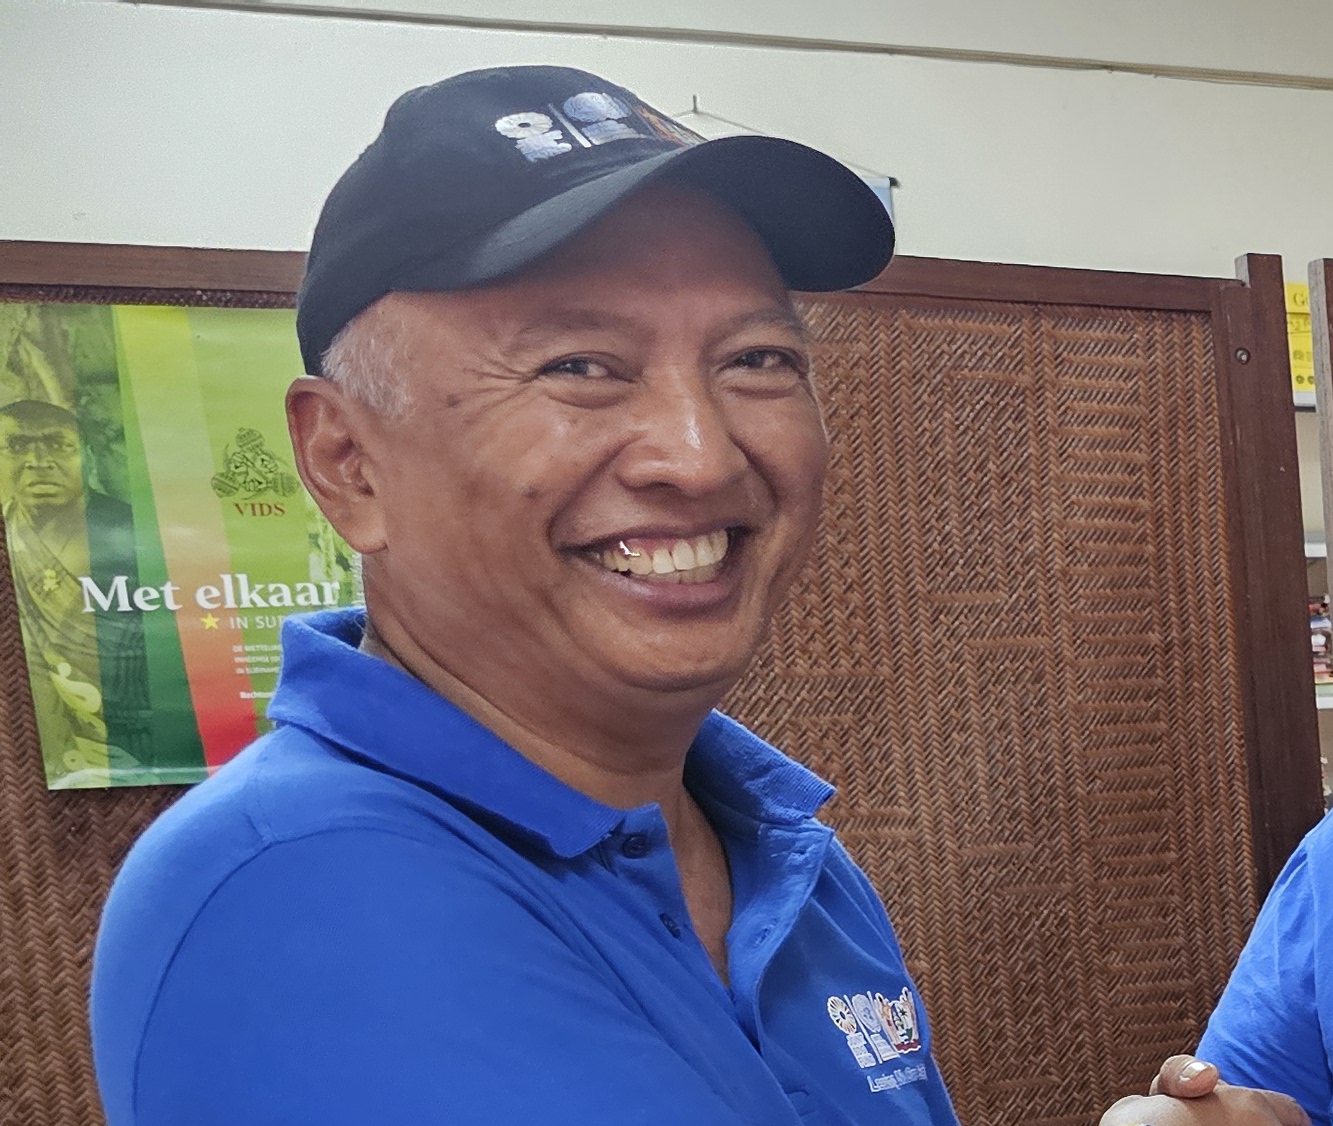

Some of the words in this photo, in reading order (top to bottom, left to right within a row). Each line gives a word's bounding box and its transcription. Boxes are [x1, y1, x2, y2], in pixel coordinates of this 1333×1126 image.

[233, 502, 286, 517] VIDS
[78, 575, 183, 613] Met
[194, 573, 340, 609] elkaar
[229, 616, 249, 629] IN
